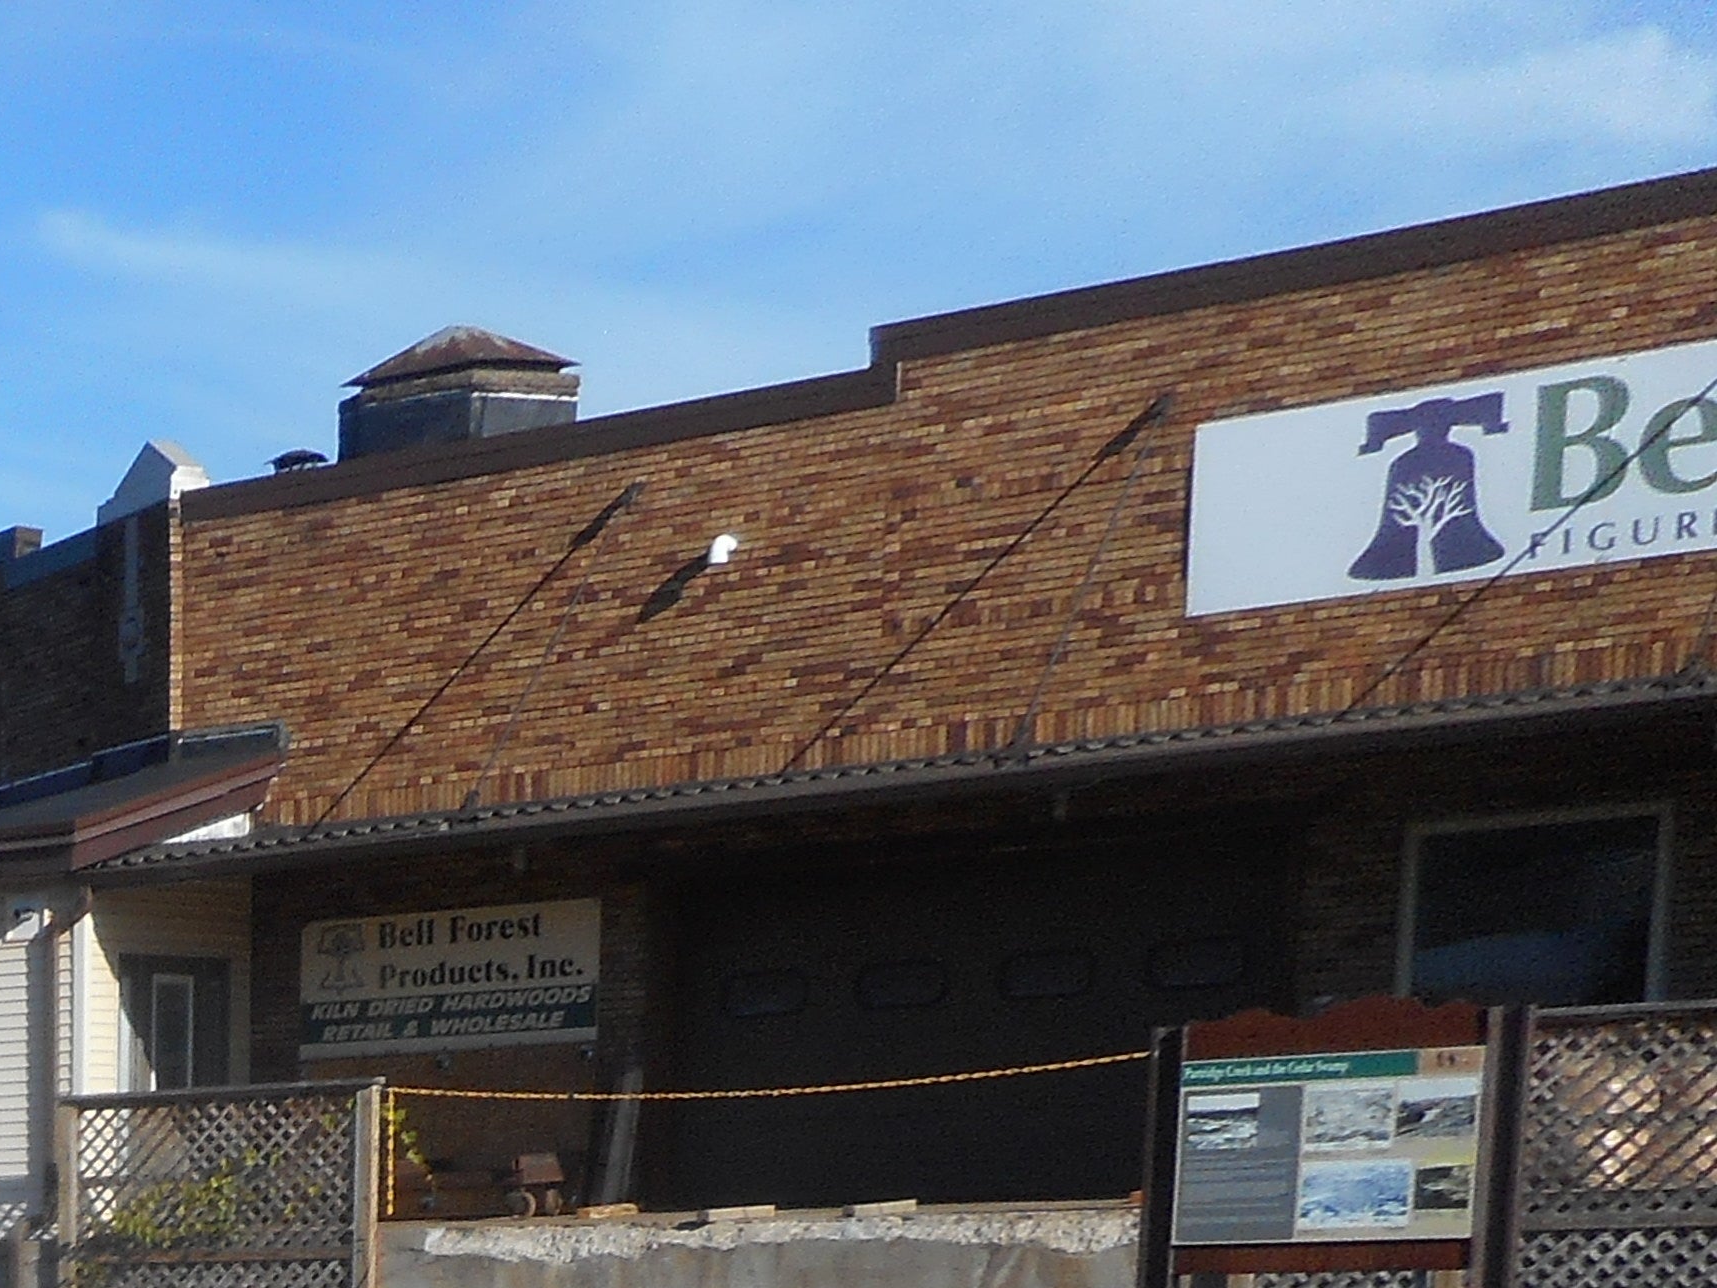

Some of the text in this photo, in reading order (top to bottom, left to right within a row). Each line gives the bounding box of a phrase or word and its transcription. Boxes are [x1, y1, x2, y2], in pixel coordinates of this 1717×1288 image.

[1528, 509, 1717, 559] FIGUR
[378, 912, 542, 950] Bell Forest
[527, 953, 584, 979] Inc.
[310, 985, 593, 1022] KILN DRIED HARDWOODS
[322, 1010, 566, 1043] RETAIL & WHOLESALE
[1253, 1063, 1270, 1075] and
